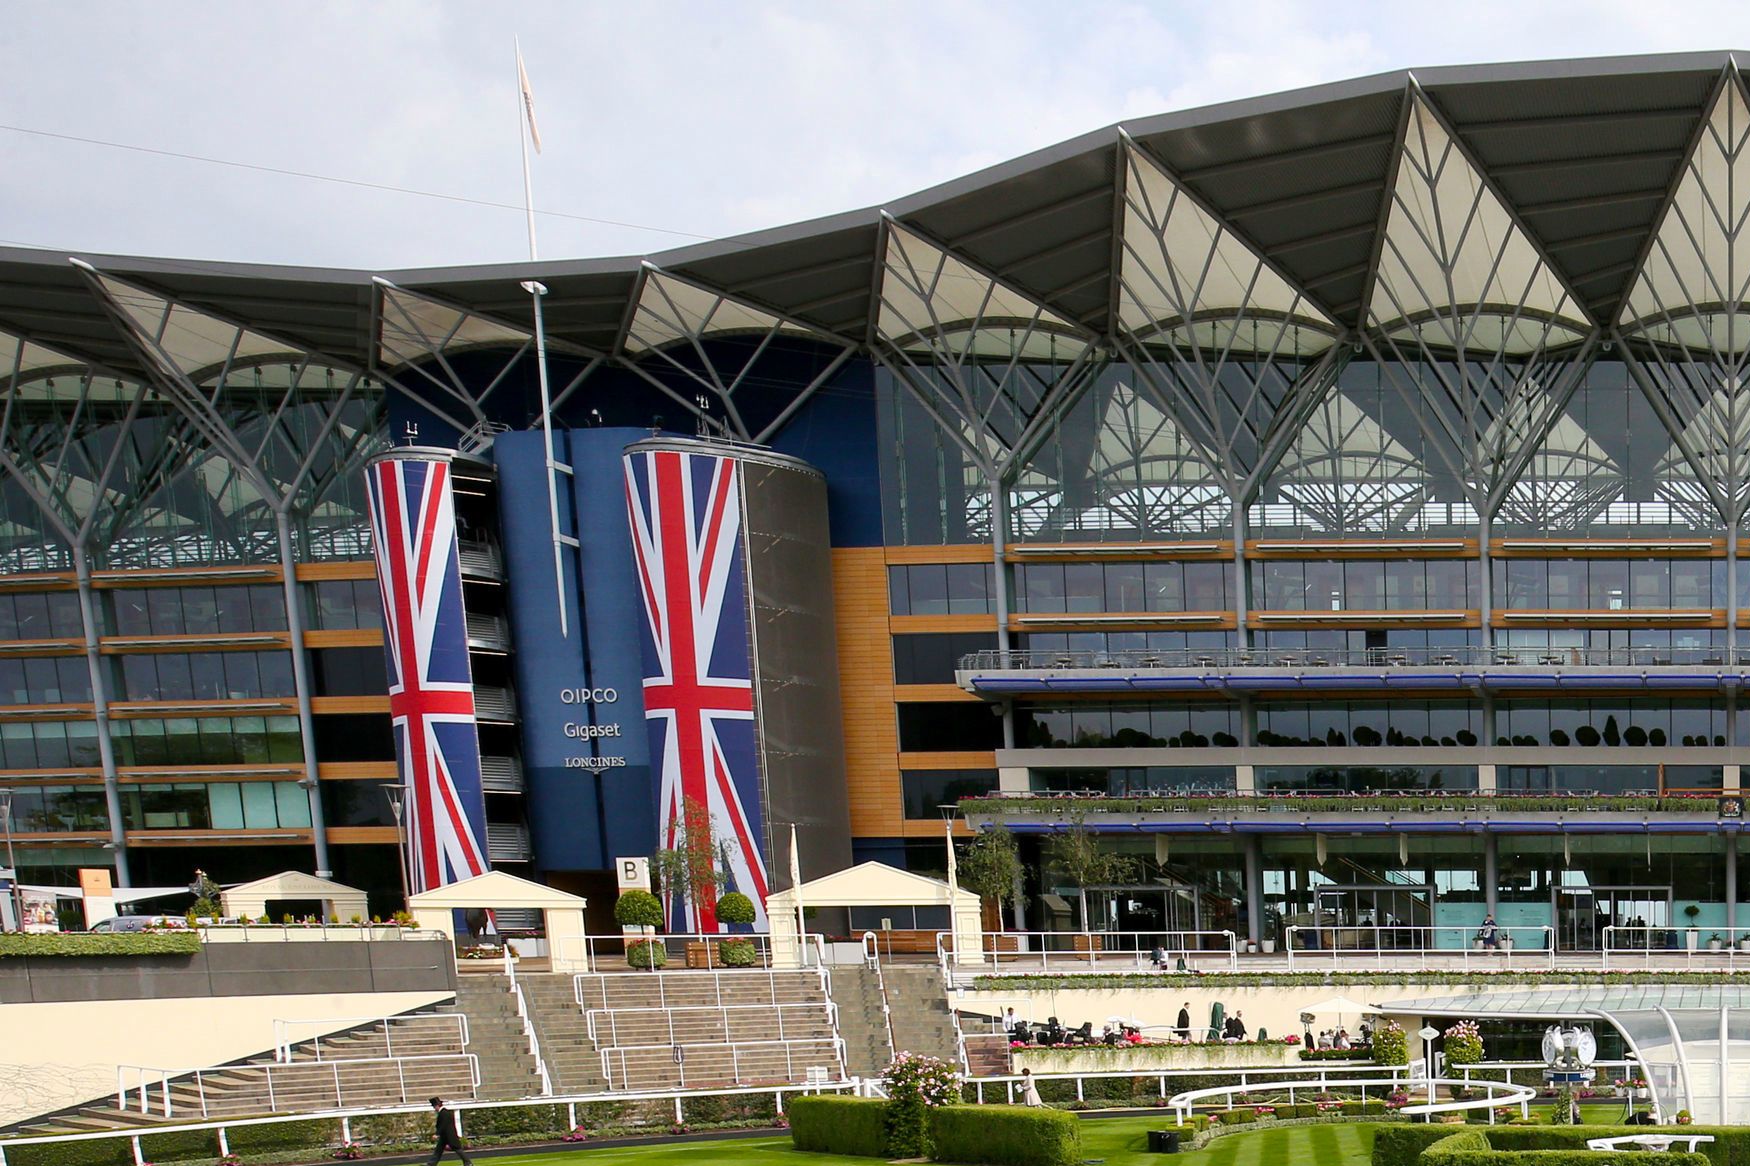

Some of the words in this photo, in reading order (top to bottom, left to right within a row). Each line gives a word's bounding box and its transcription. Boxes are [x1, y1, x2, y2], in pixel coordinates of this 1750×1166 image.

[560, 688, 617, 704] QIPCO
[564, 722, 621, 741] Gigaset
[564, 757, 626, 767] LONGINES
[623, 861, 638, 881] B
